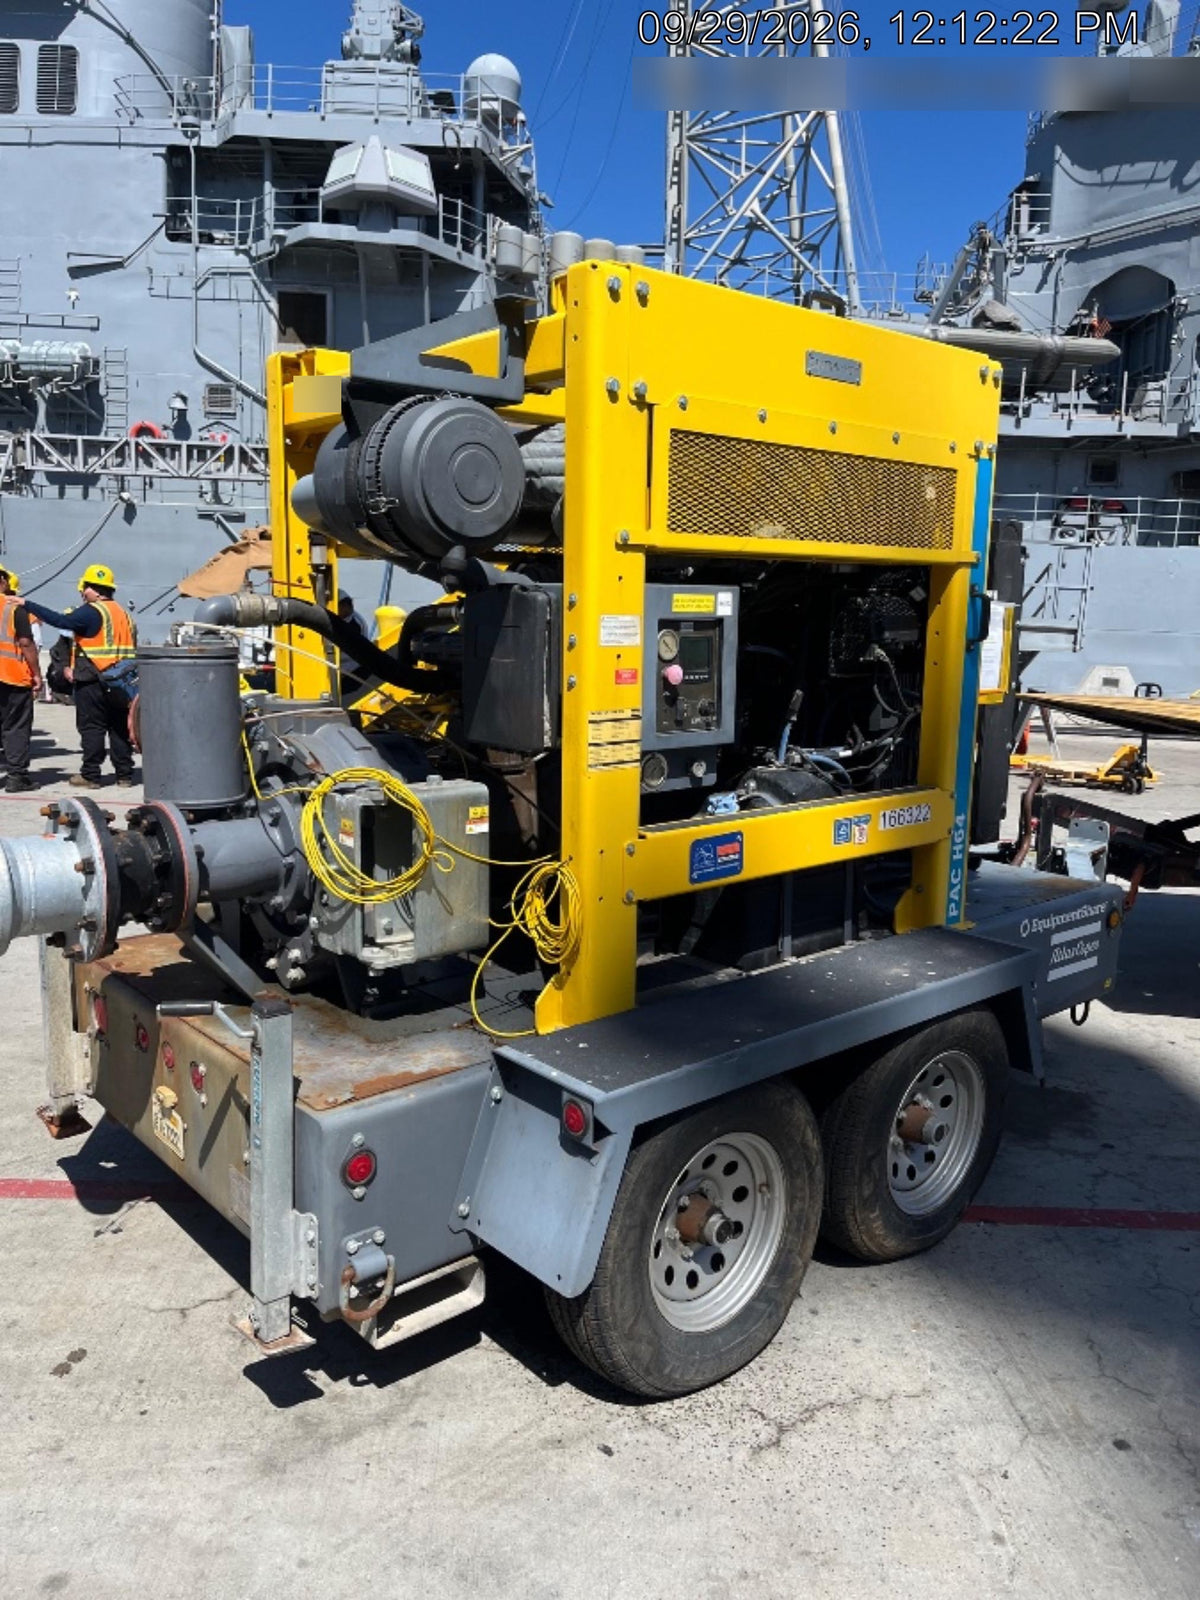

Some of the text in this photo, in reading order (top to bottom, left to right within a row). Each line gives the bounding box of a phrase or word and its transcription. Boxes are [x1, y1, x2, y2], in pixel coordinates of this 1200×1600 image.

[881, 803, 931, 829] 166322
[949, 813, 966, 918] PAC H64
[1031, 903, 1107, 933] EquipmentShare
